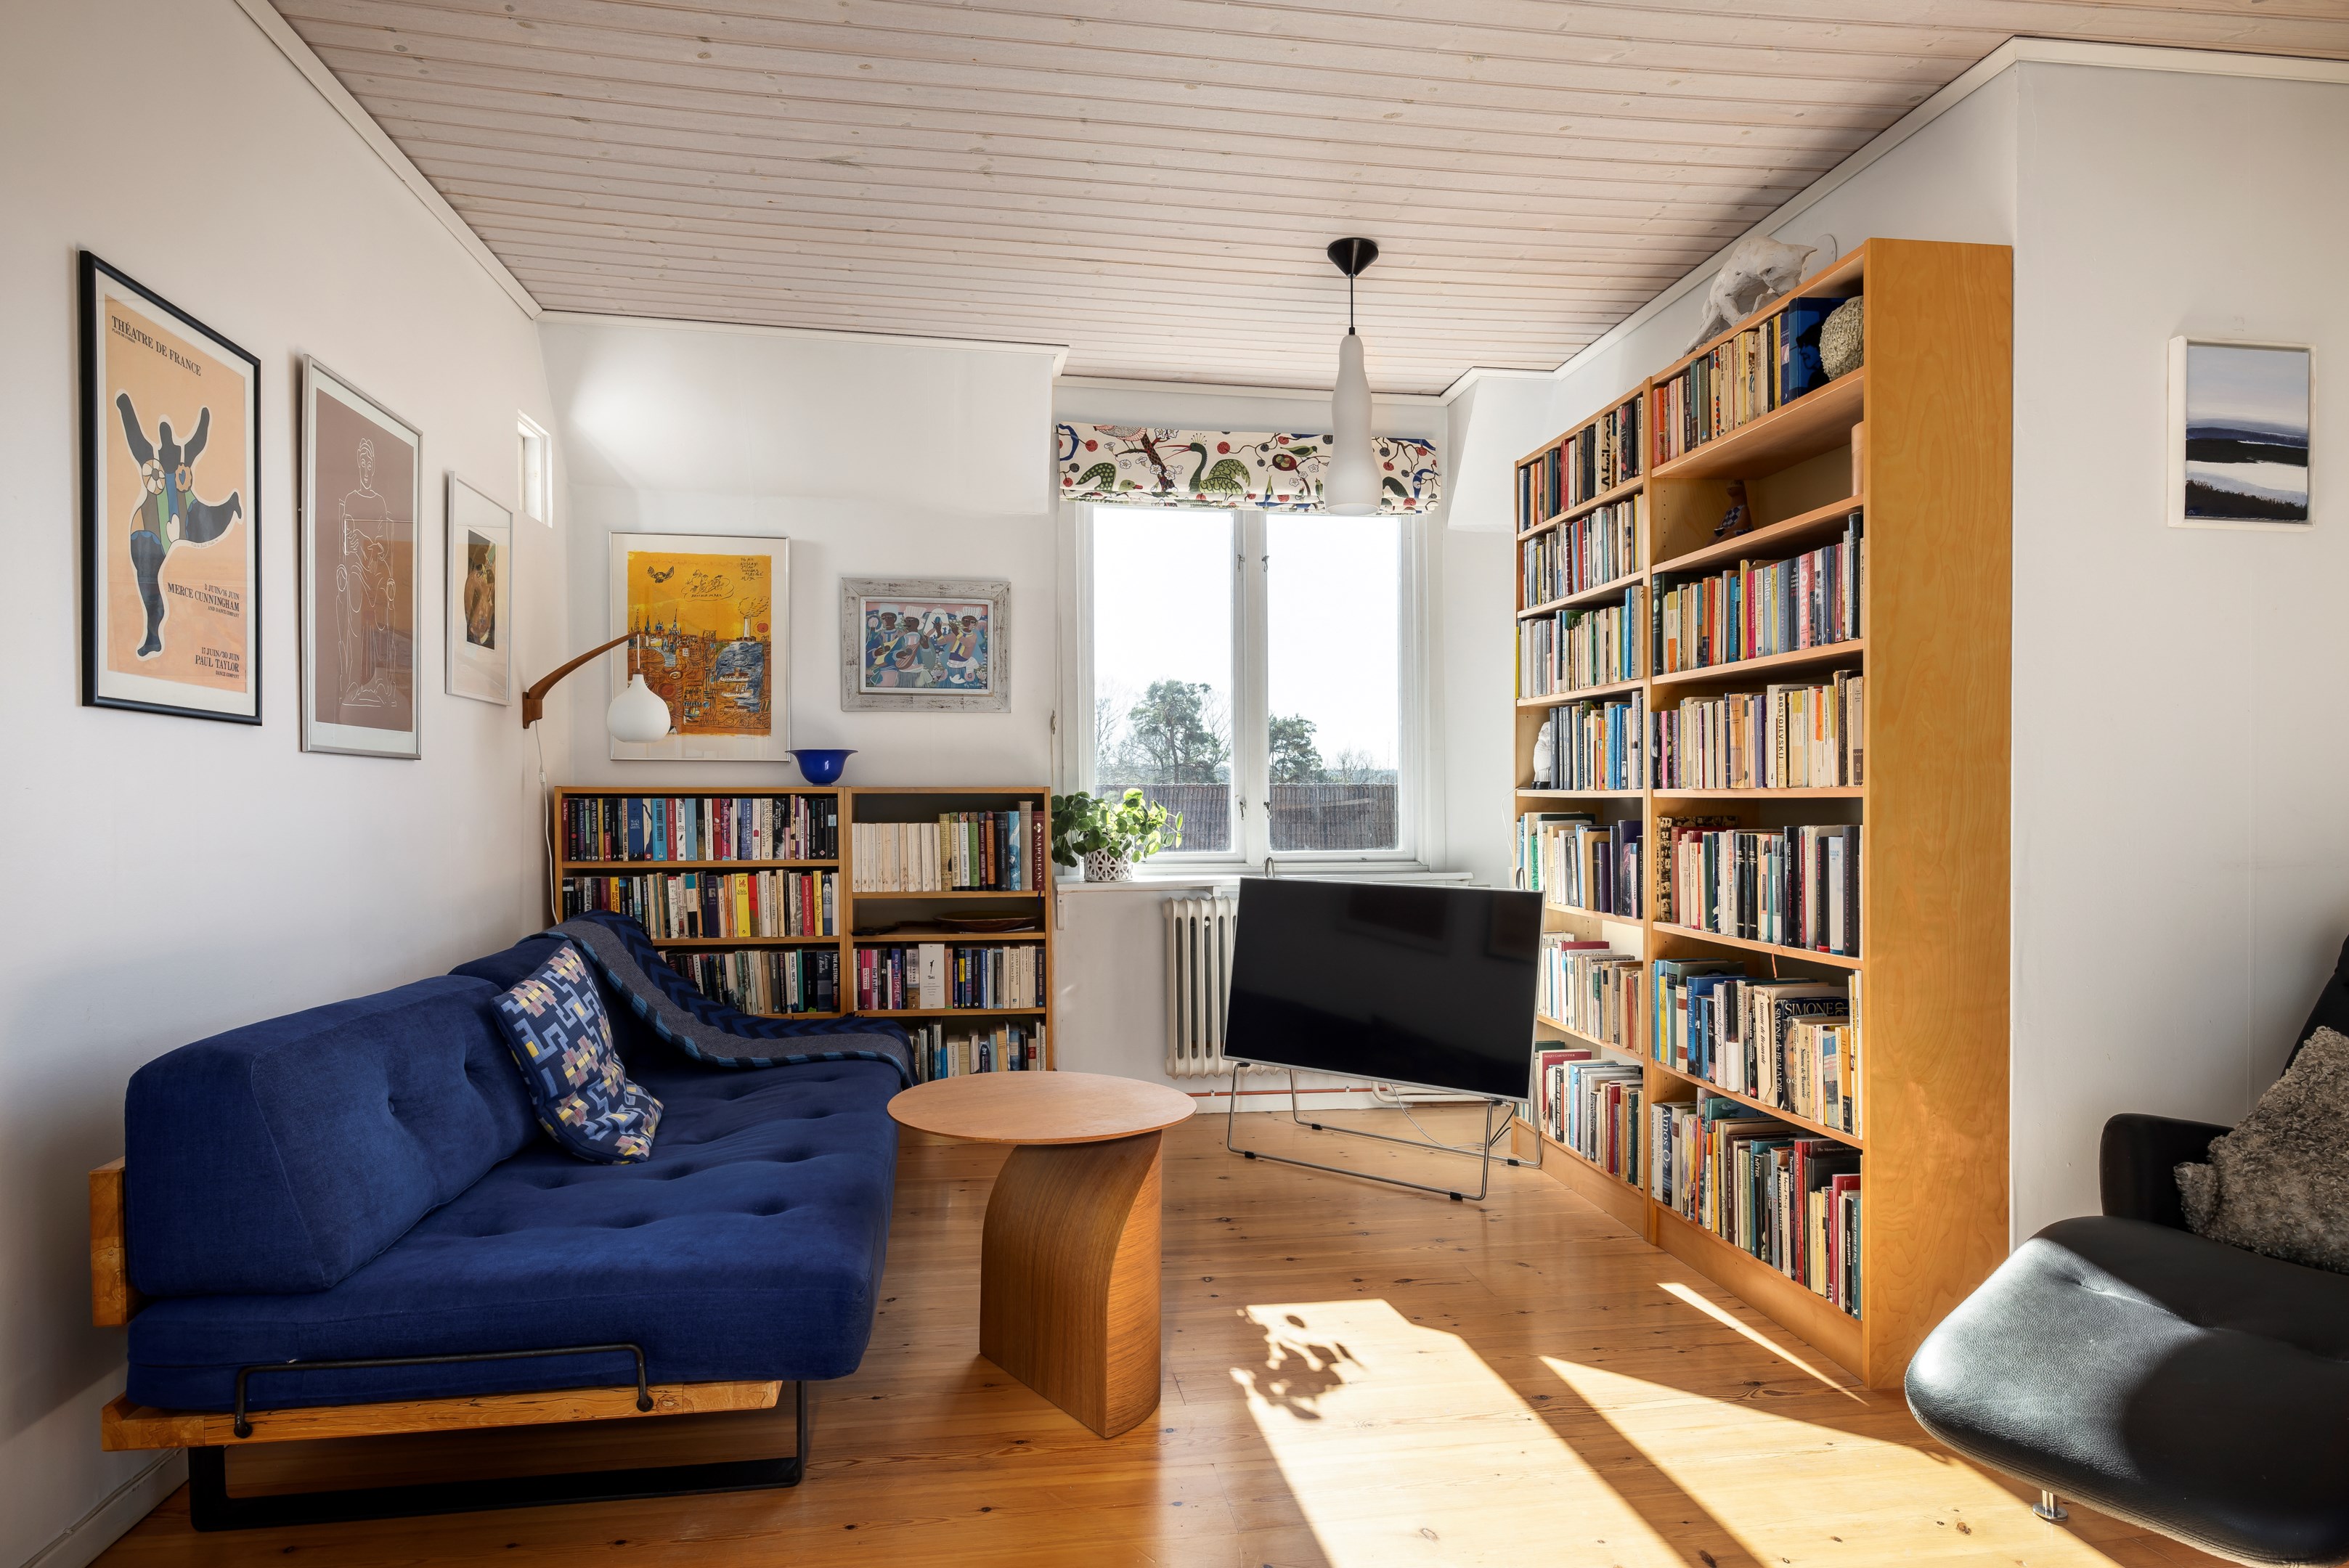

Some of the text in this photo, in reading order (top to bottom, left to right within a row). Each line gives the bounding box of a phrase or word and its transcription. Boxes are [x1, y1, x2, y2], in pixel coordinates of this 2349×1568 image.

[155, 340, 167, 357] DE
[169, 348, 201, 377] FRANCE
[168, 581, 240, 612] MERCE CUNNINGHAM
[228, 589, 240, 600] JUIN
[195, 655, 240, 672] PAUL TAYLOR
[229, 653, 240, 661] JUIN
[1785, 1003, 1833, 1017] SIMONE
[1775, 1040, 1781, 1050] de
[1663, 1148, 1671, 1169] Oz
